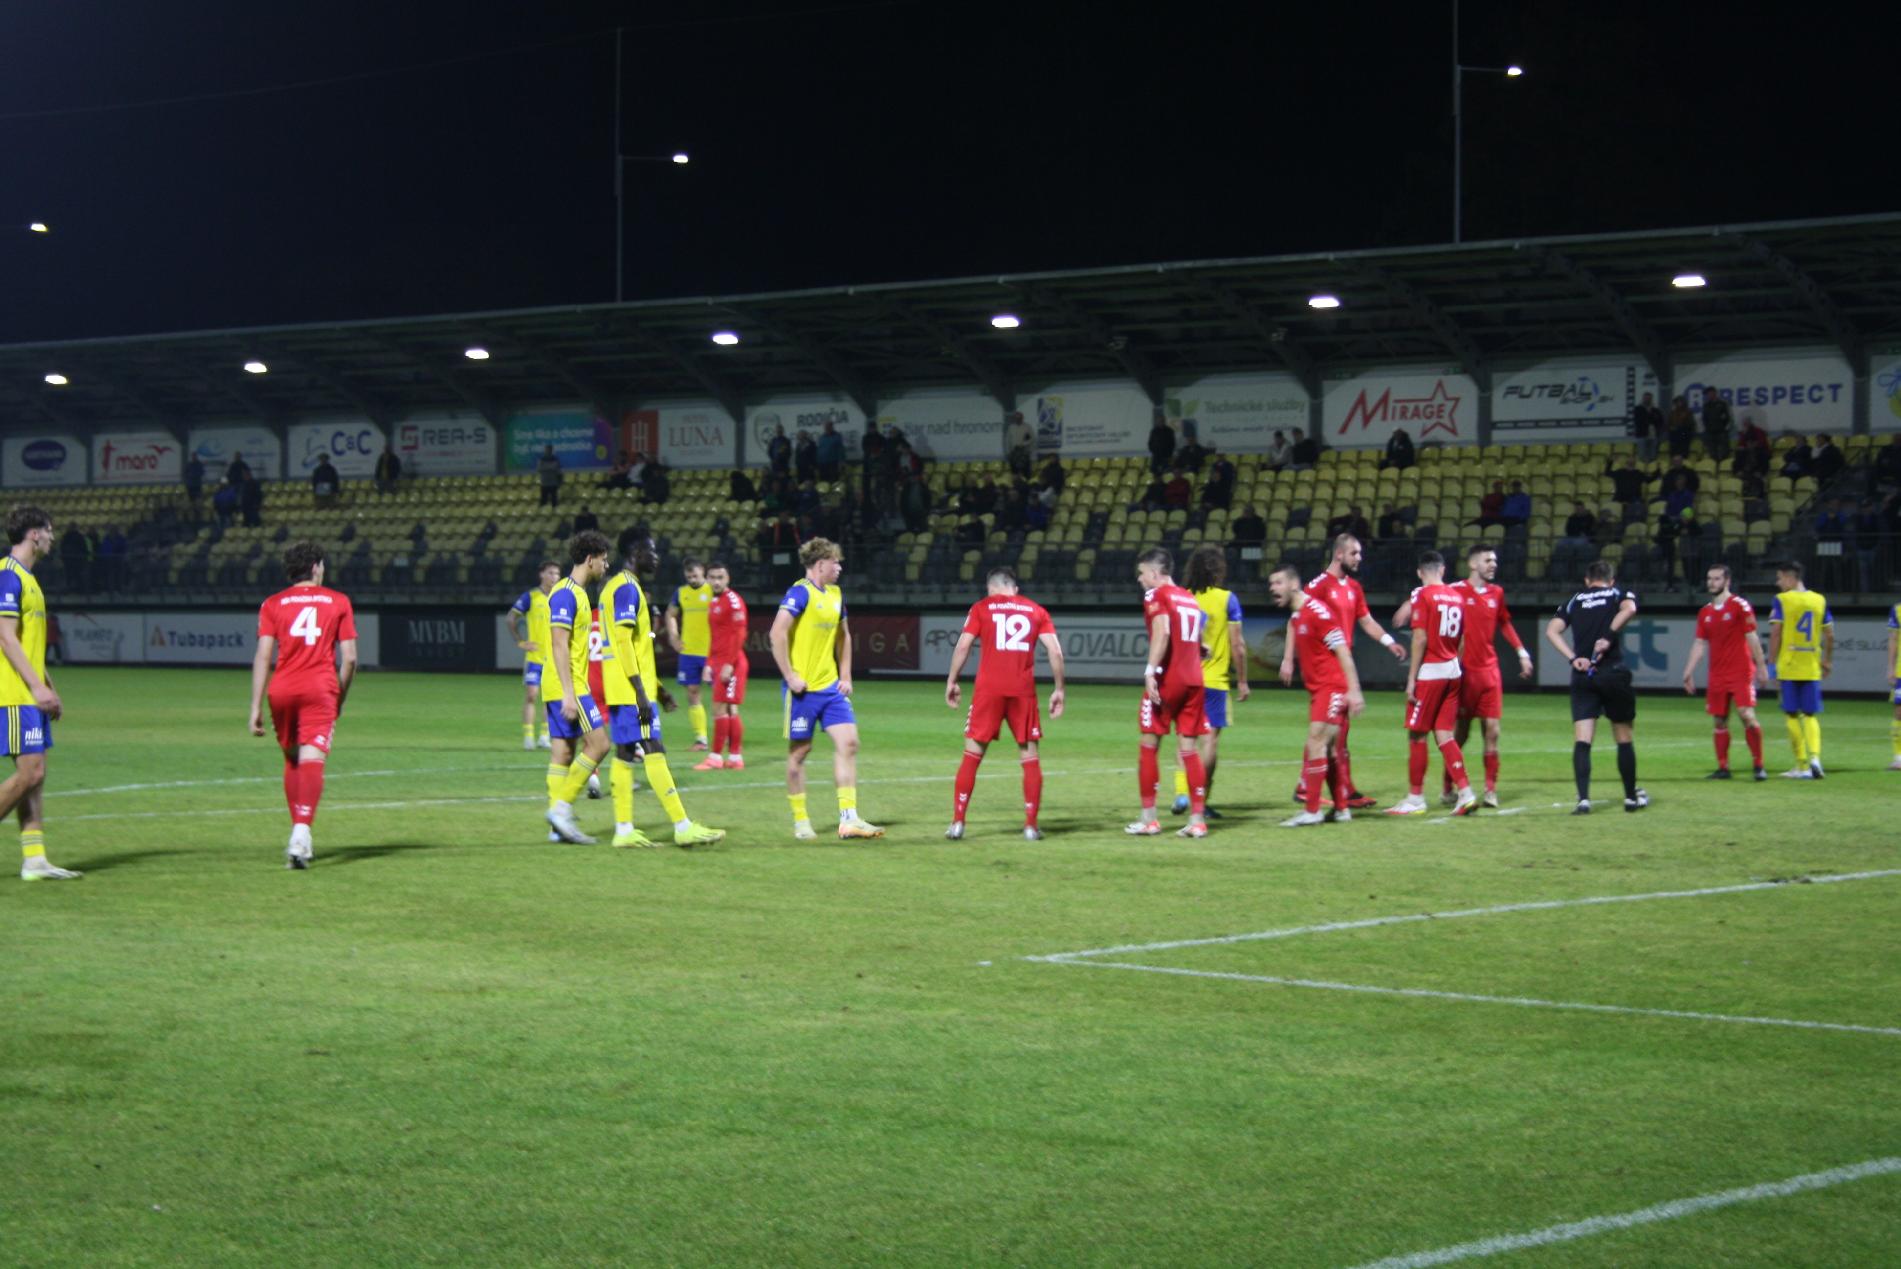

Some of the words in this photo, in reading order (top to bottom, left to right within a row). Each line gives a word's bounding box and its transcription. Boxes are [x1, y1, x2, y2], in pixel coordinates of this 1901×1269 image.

[1502, 383, 1593, 399] FUTBAL
[1720, 383, 1843, 407] RESPECT
[1338, 386, 1446, 435] MIRAGE
[668, 425, 725, 448] LUNA
[928, 419, 952, 435] nad
[331, 429, 372, 457] C&C
[289, 605, 322, 647] 4
[992, 613, 1032, 652] 12
[1176, 604, 1200, 642] 17
[1437, 604, 1462, 638] 18
[1796, 611, 1813, 642] 4
[167, 629, 246, 650] Tubapack
